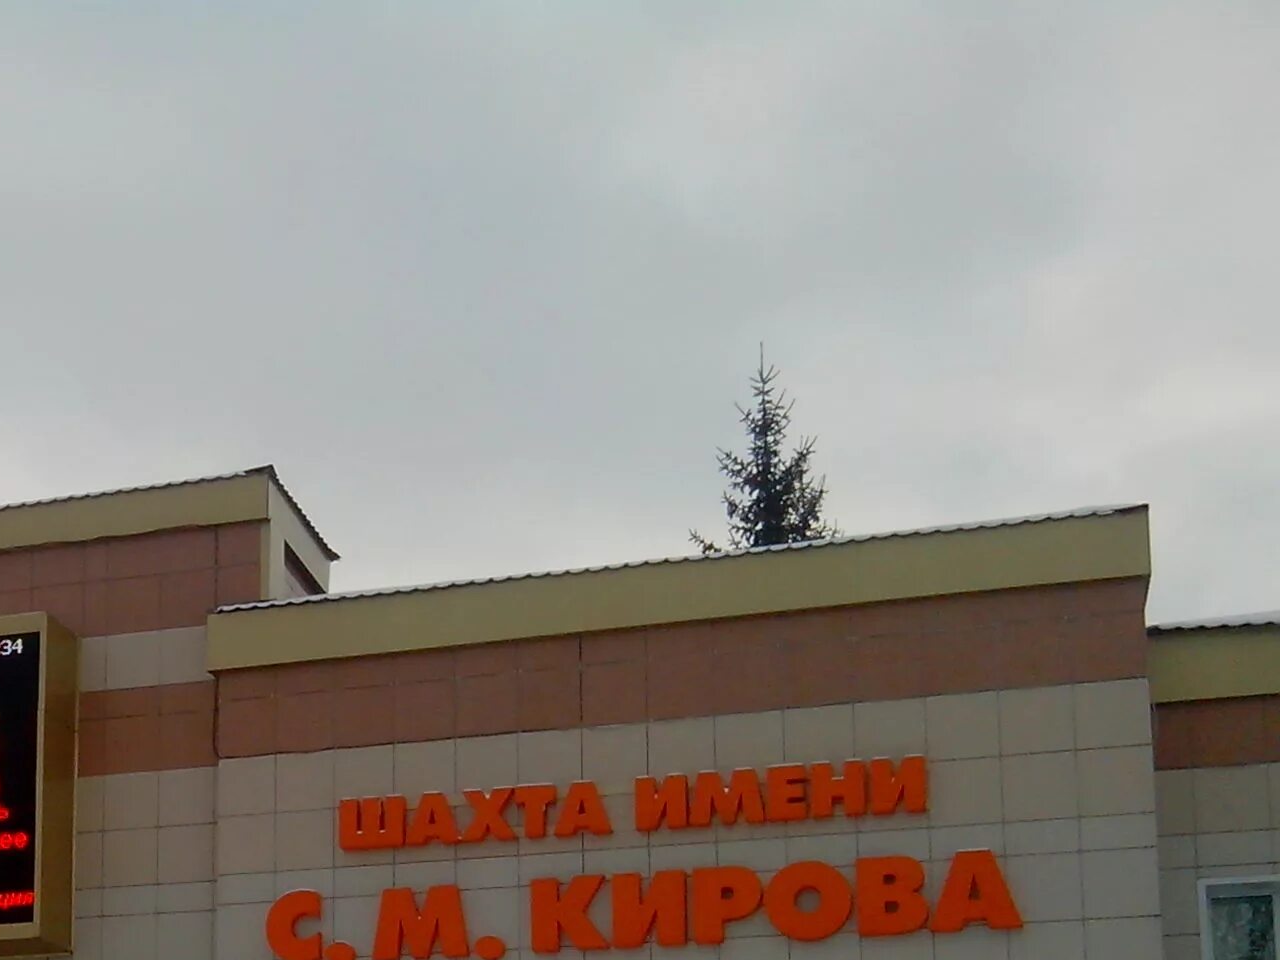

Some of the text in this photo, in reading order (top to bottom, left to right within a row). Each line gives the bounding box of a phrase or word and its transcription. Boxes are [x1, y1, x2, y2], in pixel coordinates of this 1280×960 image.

[337, 755, 928, 852] ШАХТА ИМЕНИ
[528, 848, 1024, 955] КИРОВА
